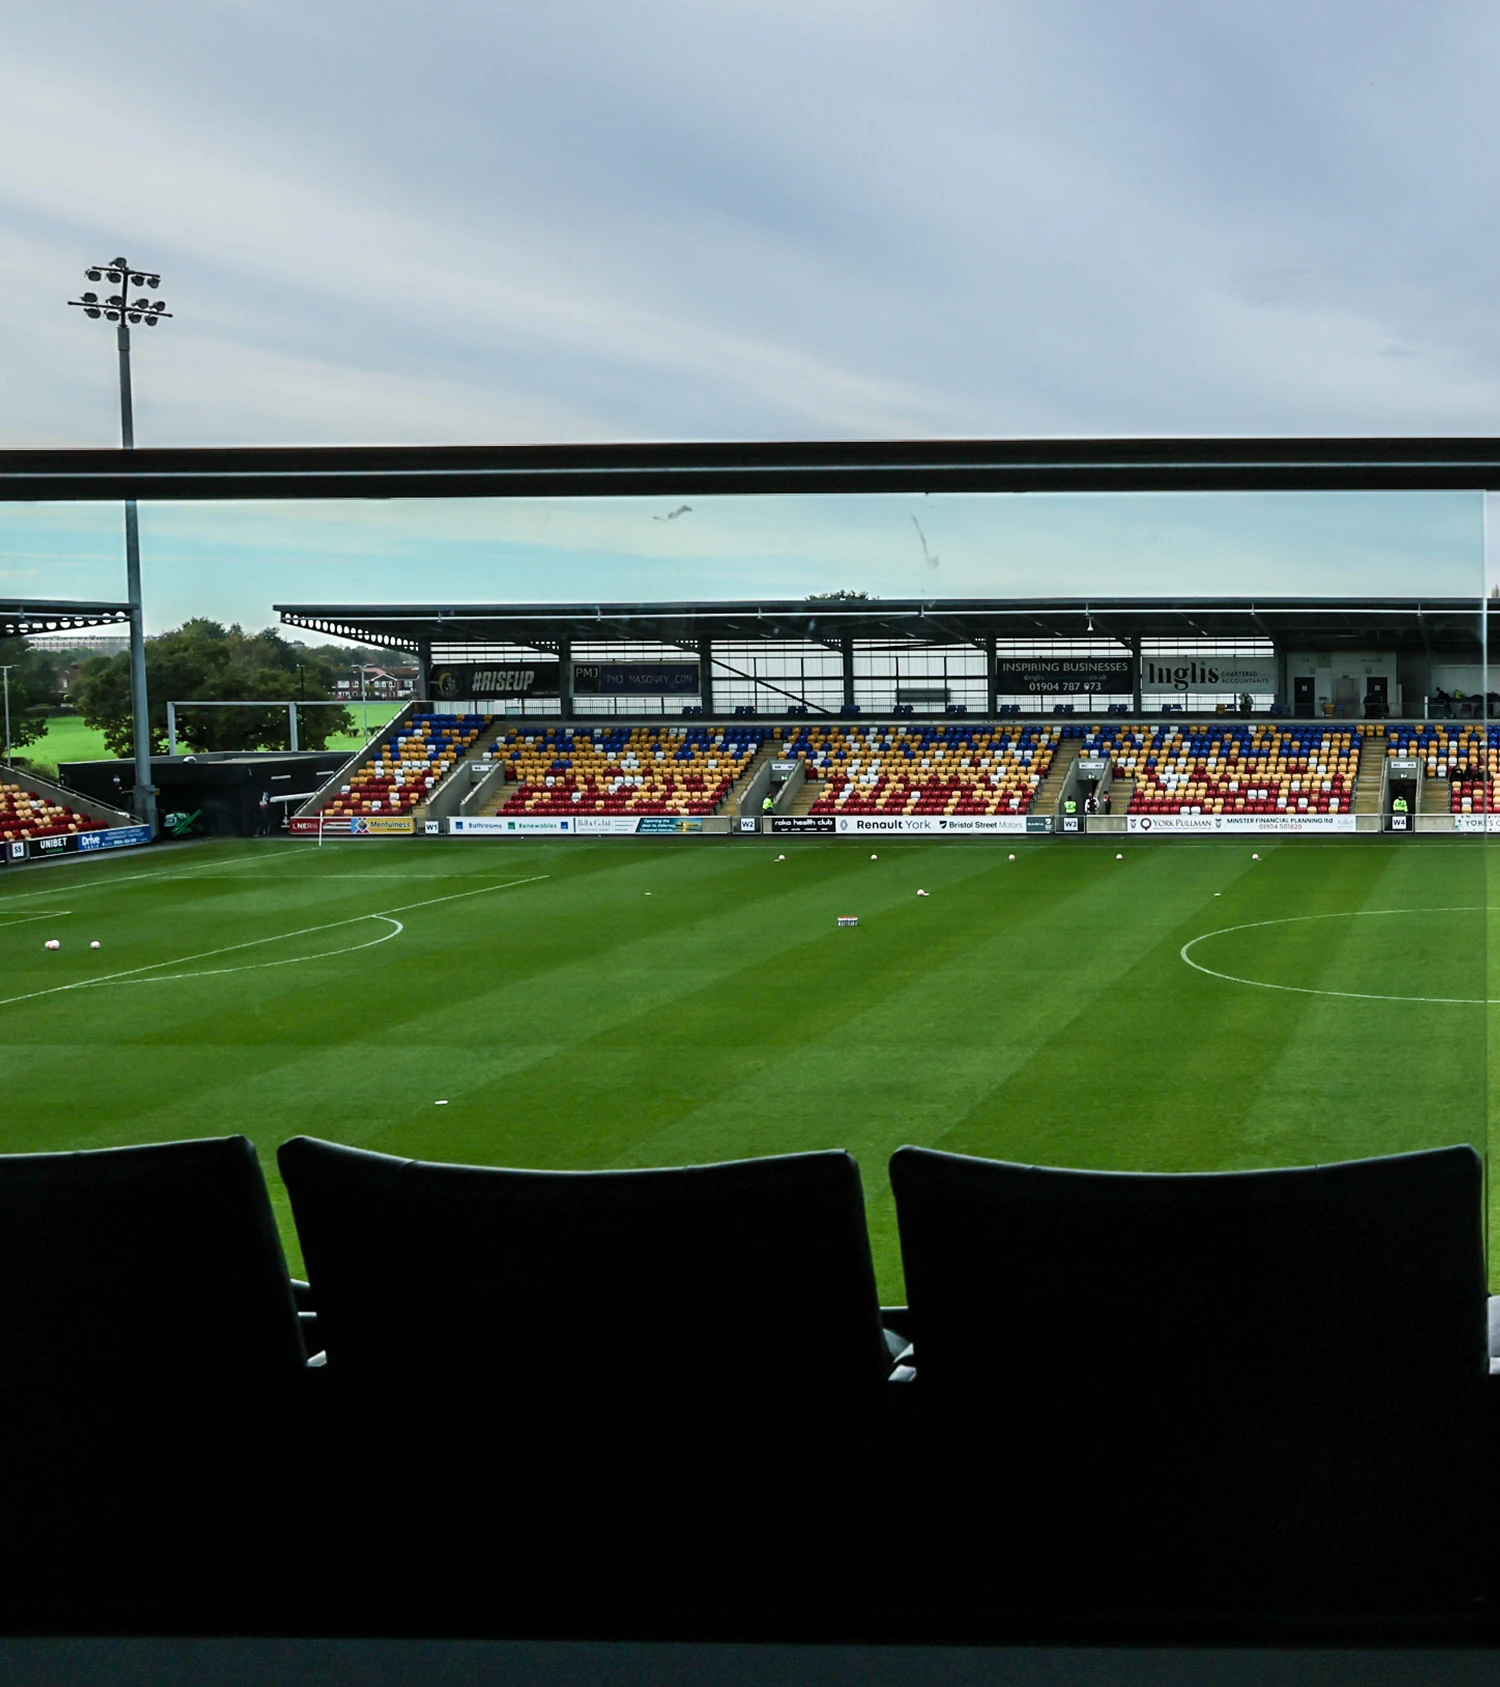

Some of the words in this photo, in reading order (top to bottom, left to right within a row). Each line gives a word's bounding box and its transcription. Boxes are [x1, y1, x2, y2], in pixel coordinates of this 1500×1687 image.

[1002, 662, 1059, 672] INSPIRING
[1063, 662, 1128, 672] BUSINESSES
[576, 667, 599, 678] PMJ
[1148, 661, 1219, 691] Inglis
[472, 671, 534, 691] #RISEUP
[1029, 682, 1060, 691] 01904
[1062, 682, 1081, 691] 787
[426, 823, 438, 831] W1
[742, 820, 754, 828] W2
[856, 820, 903, 829] Renault
[905, 820, 931, 829] York
[949, 821, 973, 829] Bristol
[975, 821, 998, 829] Street
[999, 821, 1023, 829] Motors
[1153, 819, 1174, 827] YORK
[1175, 819, 1212, 827] PULLMAN
[40, 837, 68, 849] UNIBET
[81, 834, 101, 846] Drive
